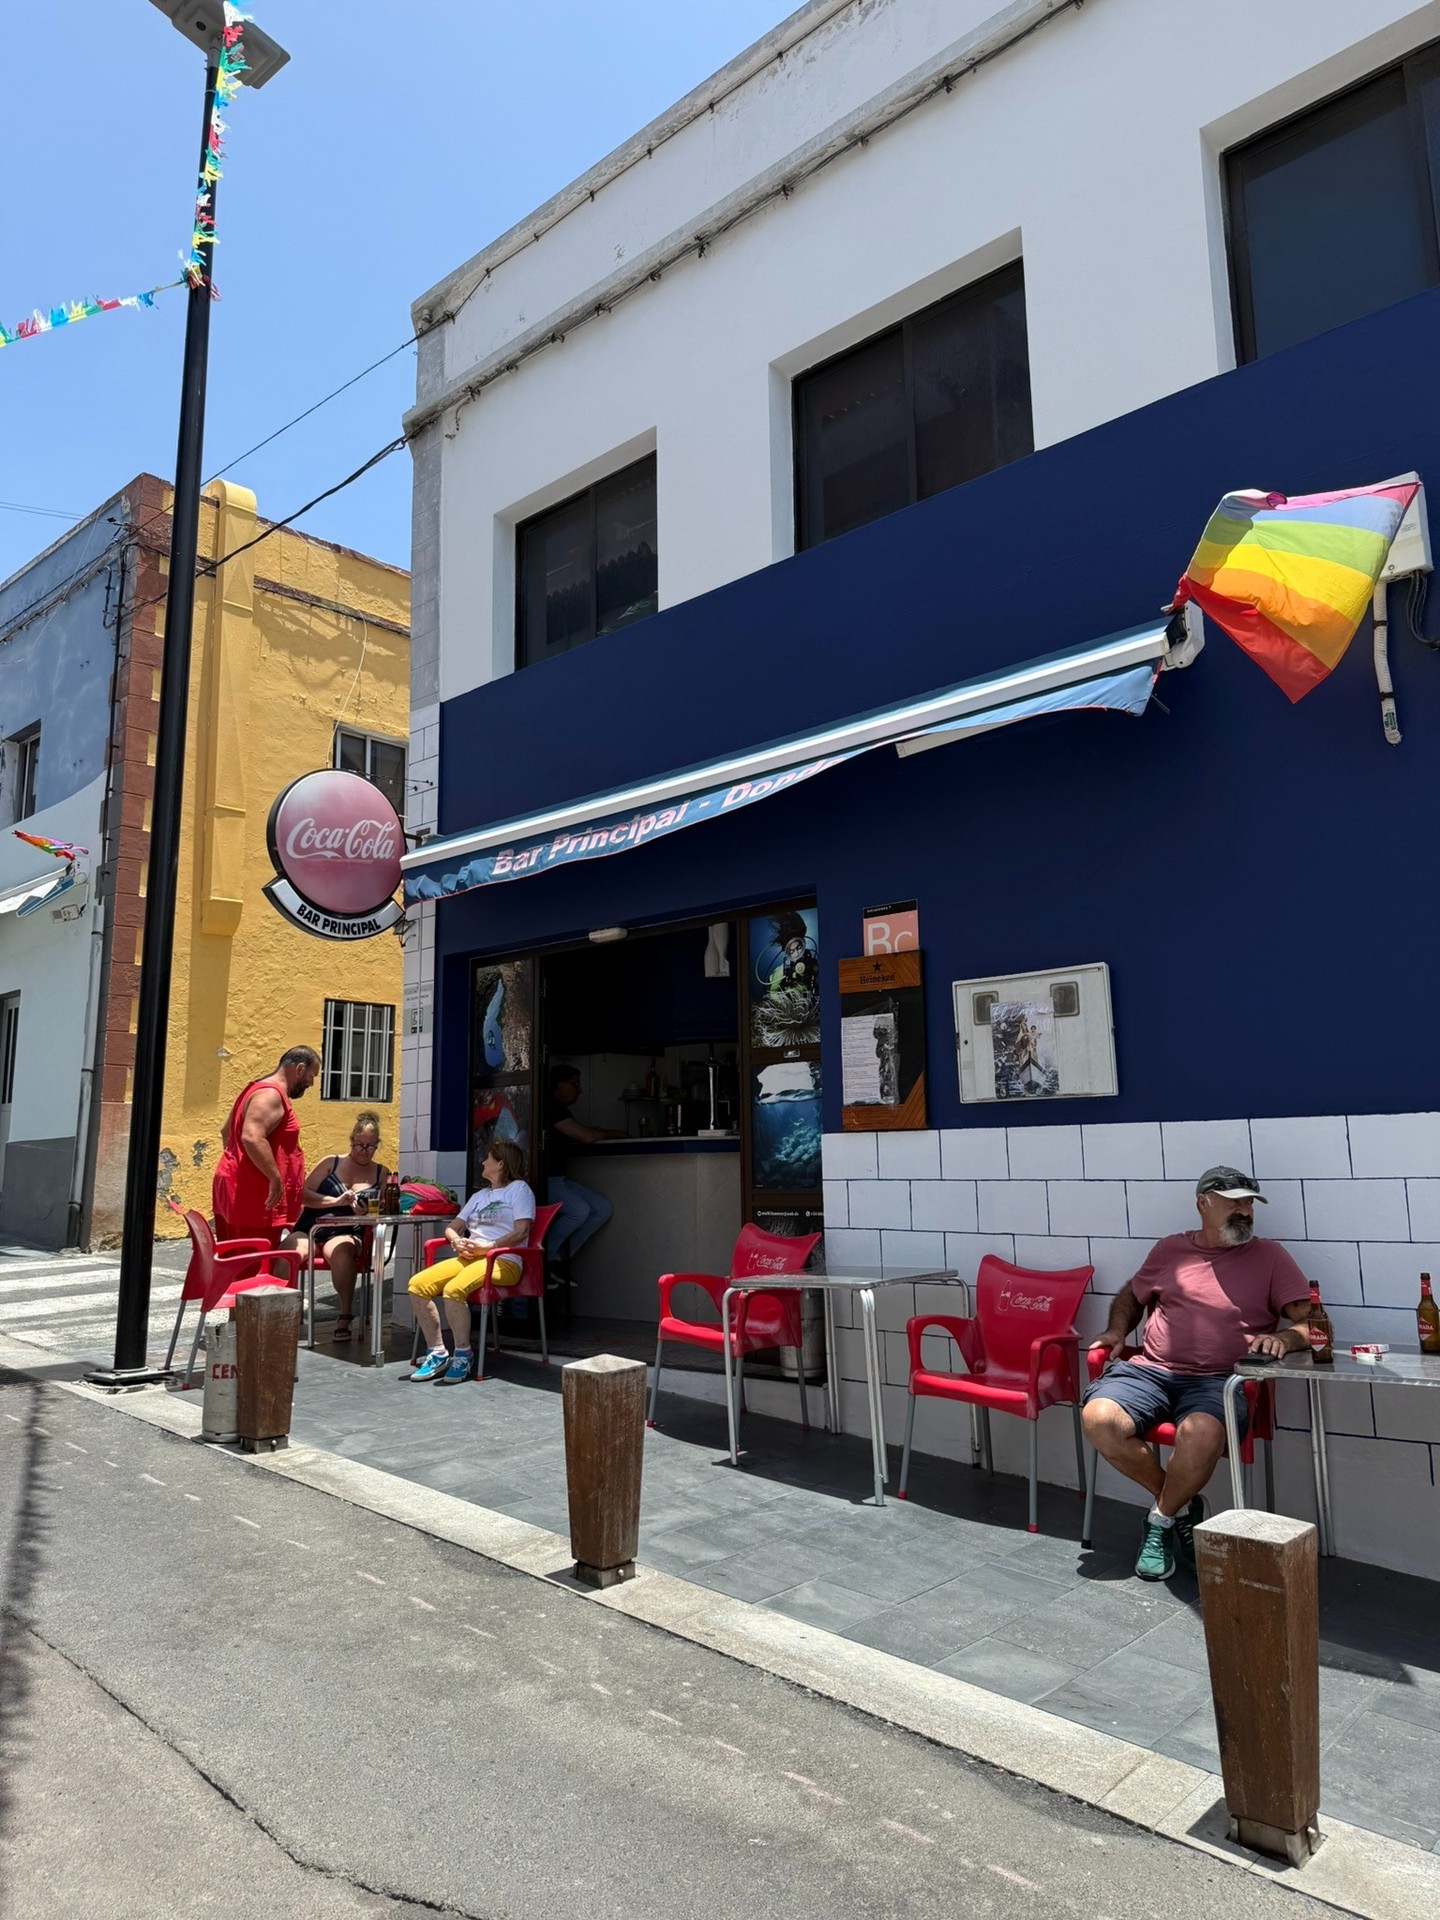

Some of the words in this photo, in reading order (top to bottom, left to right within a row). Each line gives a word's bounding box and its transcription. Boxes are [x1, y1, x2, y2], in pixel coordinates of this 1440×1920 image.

[286, 817, 397, 860] Coca-Cola
[492, 845, 543, 875] Bar
[549, 799, 692, 861] Principal
[296, 903, 321, 926] BAR
[322, 918, 382, 936] PRINCIPAL
[860, 973, 896, 985] Heineken
